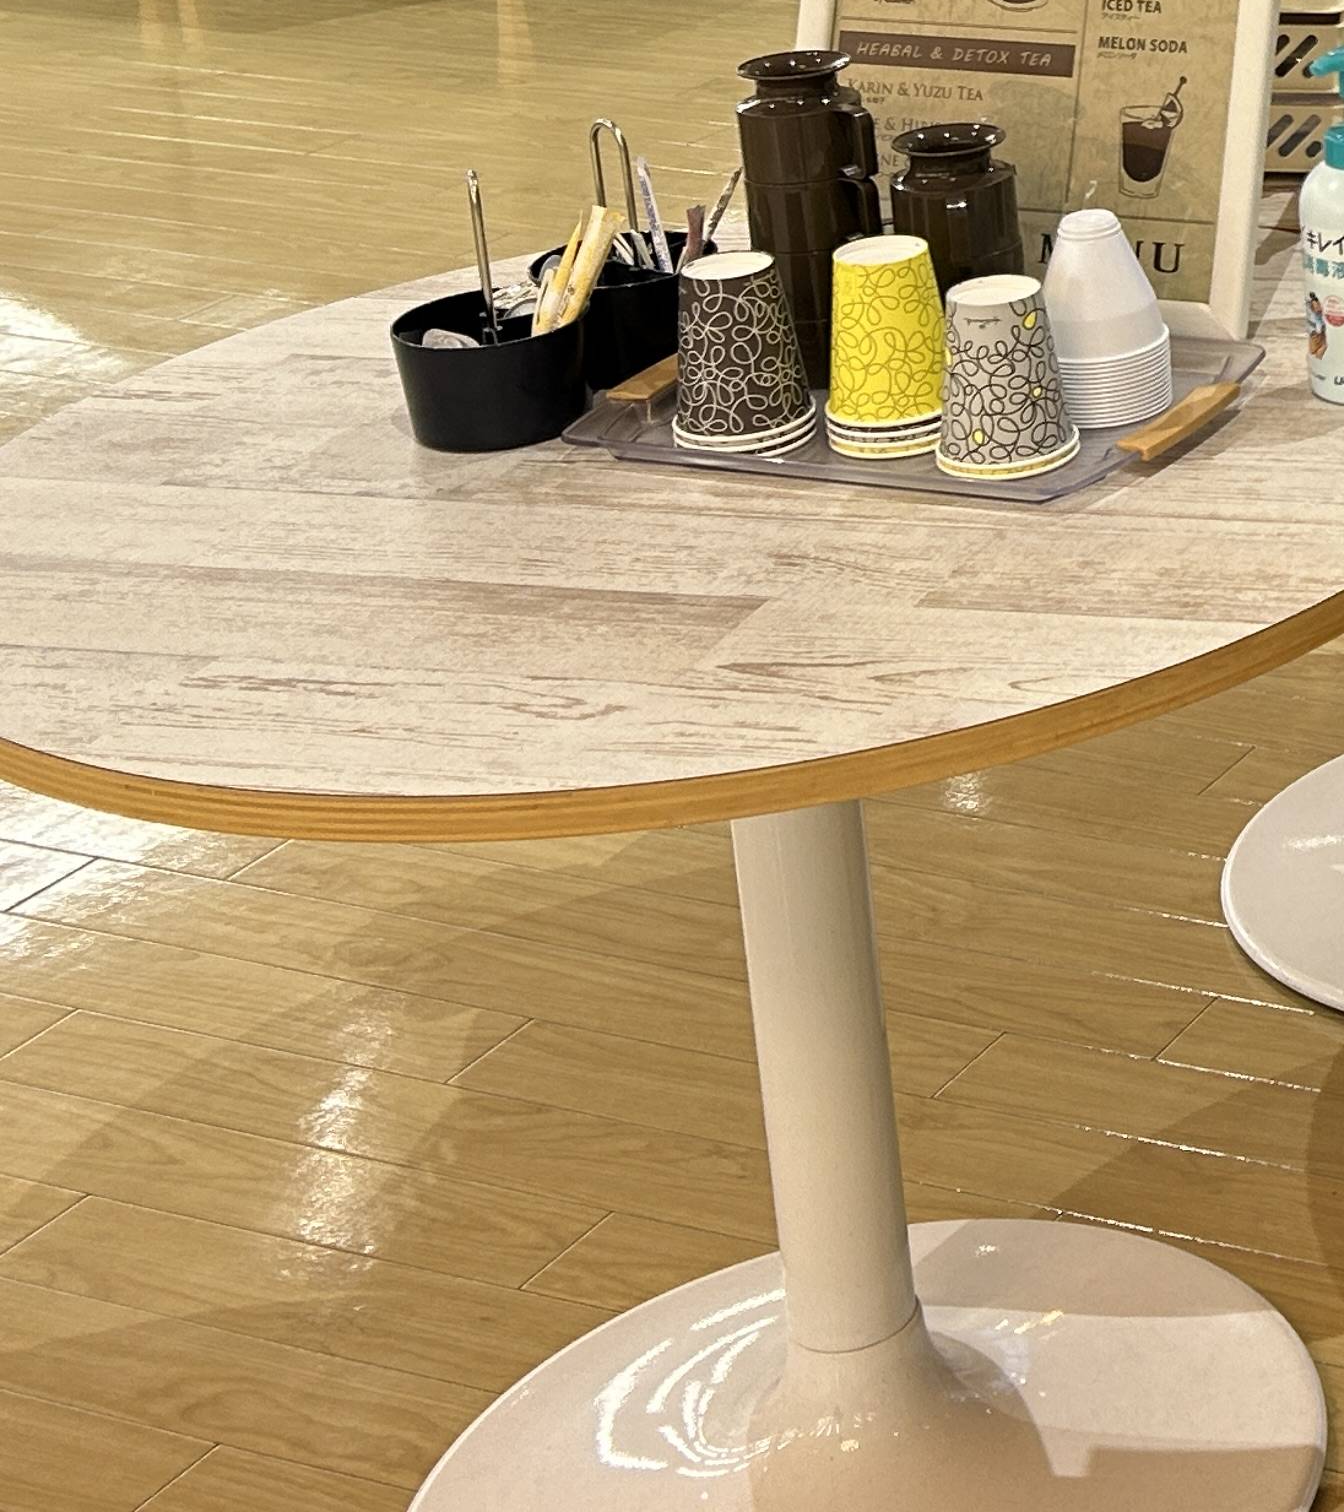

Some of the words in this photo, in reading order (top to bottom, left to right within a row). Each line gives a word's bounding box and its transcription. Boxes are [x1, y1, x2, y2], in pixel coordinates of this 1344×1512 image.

[1137, 0, 1162, 14] TEA
[1098, 36, 1146, 51] MELON
[1150, 39, 1188, 54] SODA
[929, 46, 944, 60] &
[952, 47, 1009, 65] DETOX
[1021, 51, 1052, 67] TEA
[897, 82, 911, 97] &
[1038, 233, 1185, 274] MU
